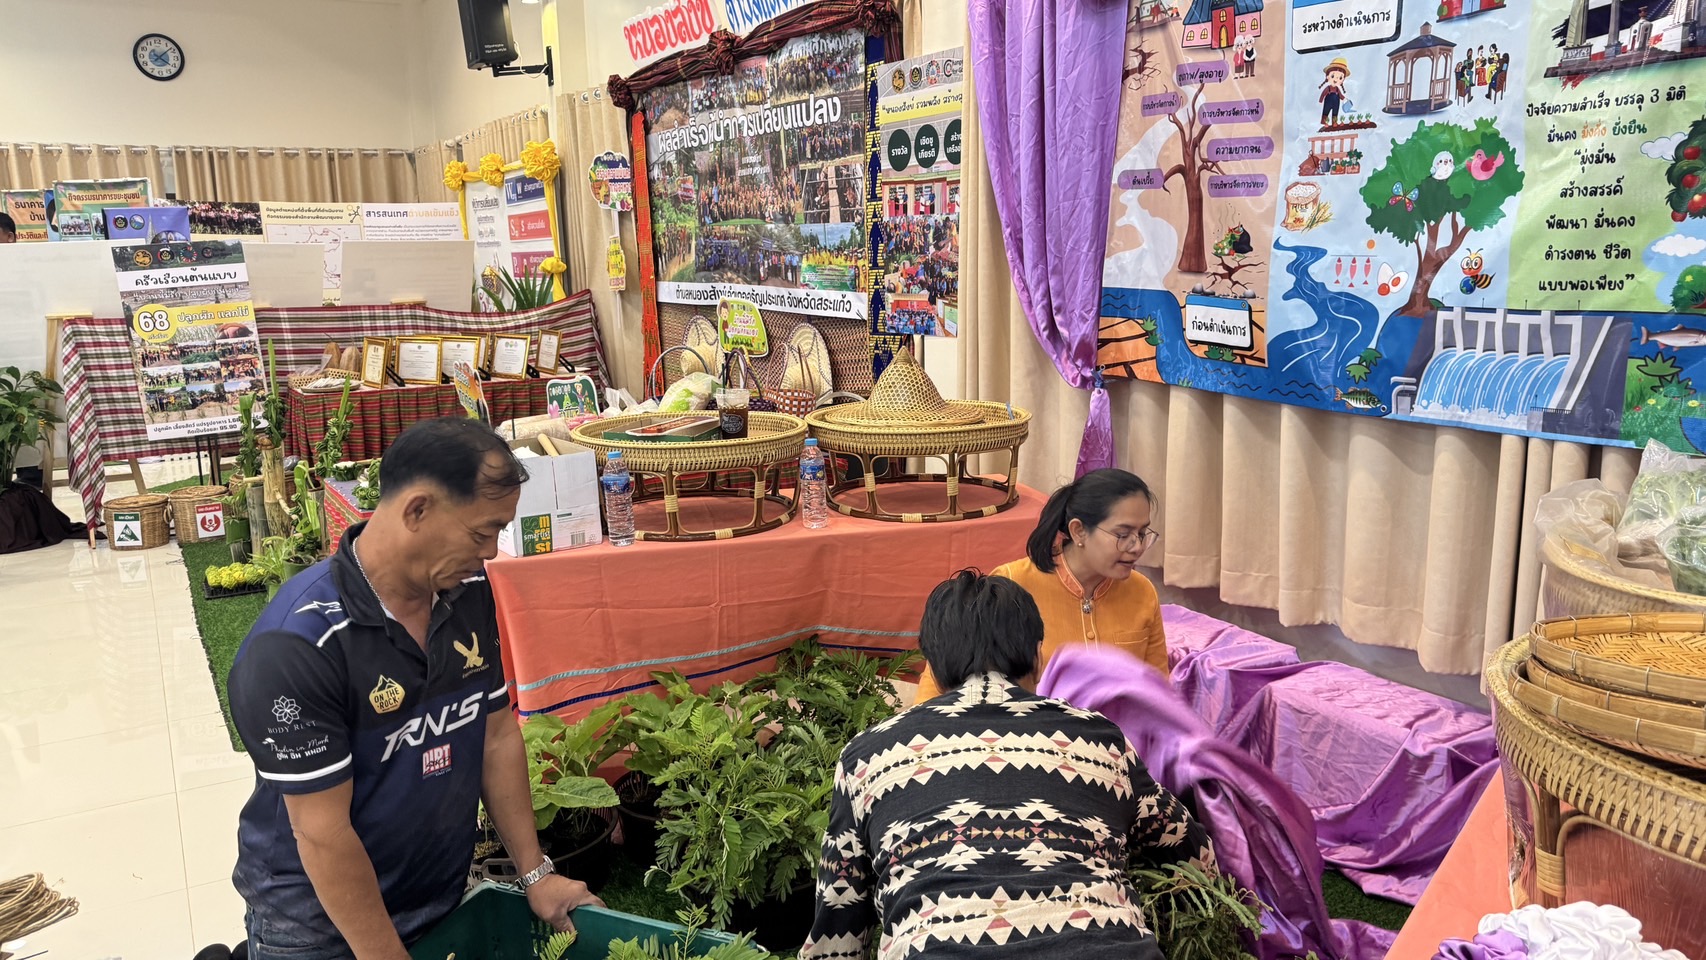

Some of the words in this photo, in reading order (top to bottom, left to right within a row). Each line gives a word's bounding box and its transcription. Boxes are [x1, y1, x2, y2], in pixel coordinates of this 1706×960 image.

[1302, 9, 1391, 34] ระหว่างดำเนินการ
[1202, 102, 1260, 119] การบริหารจัดการหนี้
[1526, 90, 1610, 117] ปัจจัยความสำเร็จ
[1615, 92, 1644, 111] บรรลุ
[1650, 88, 1660, 104] 3
[1666, 86, 1686, 101] มิติ
[658, 92, 842, 153] ผลสำเร็จผู้นำการเปลี่ยนแปลง
[1547, 124, 1577, 143] มั่นคง
[1612, 118, 1647, 136] ยั่งยืน
[1215, 144, 1262, 156] ความยากจน
[1559, 175, 1625, 198] สร้างสรรค์
[15, 201, 45, 209] ธนาคาร
[29, 211, 46, 222] บ้าน
[1546, 213, 1588, 230] พัฒนา
[1594, 207, 1635, 229] มั่นคง
[1544, 245, 1596, 261] ดำรงตน
[1603, 242, 1631, 260] ชีวิต
[135, 267, 237, 287] ครัวเรือนต้นแบบ
[1538, 273, 1635, 291] แบบพอเพียง”
[787, 291, 852, 313] จังหวัดสระแก้ว
[138, 310, 170, 333] 68
[177, 310, 215, 324] ปลูกผัก
[1191, 316, 1247, 337] ก่อนดำเนินการ
[523, 531, 550, 540] smartist
[374, 693, 384, 703] ON
[386, 687, 400, 698] THE
[379, 697, 398, 709] ROCK
[267, 725, 290, 733] BODY
